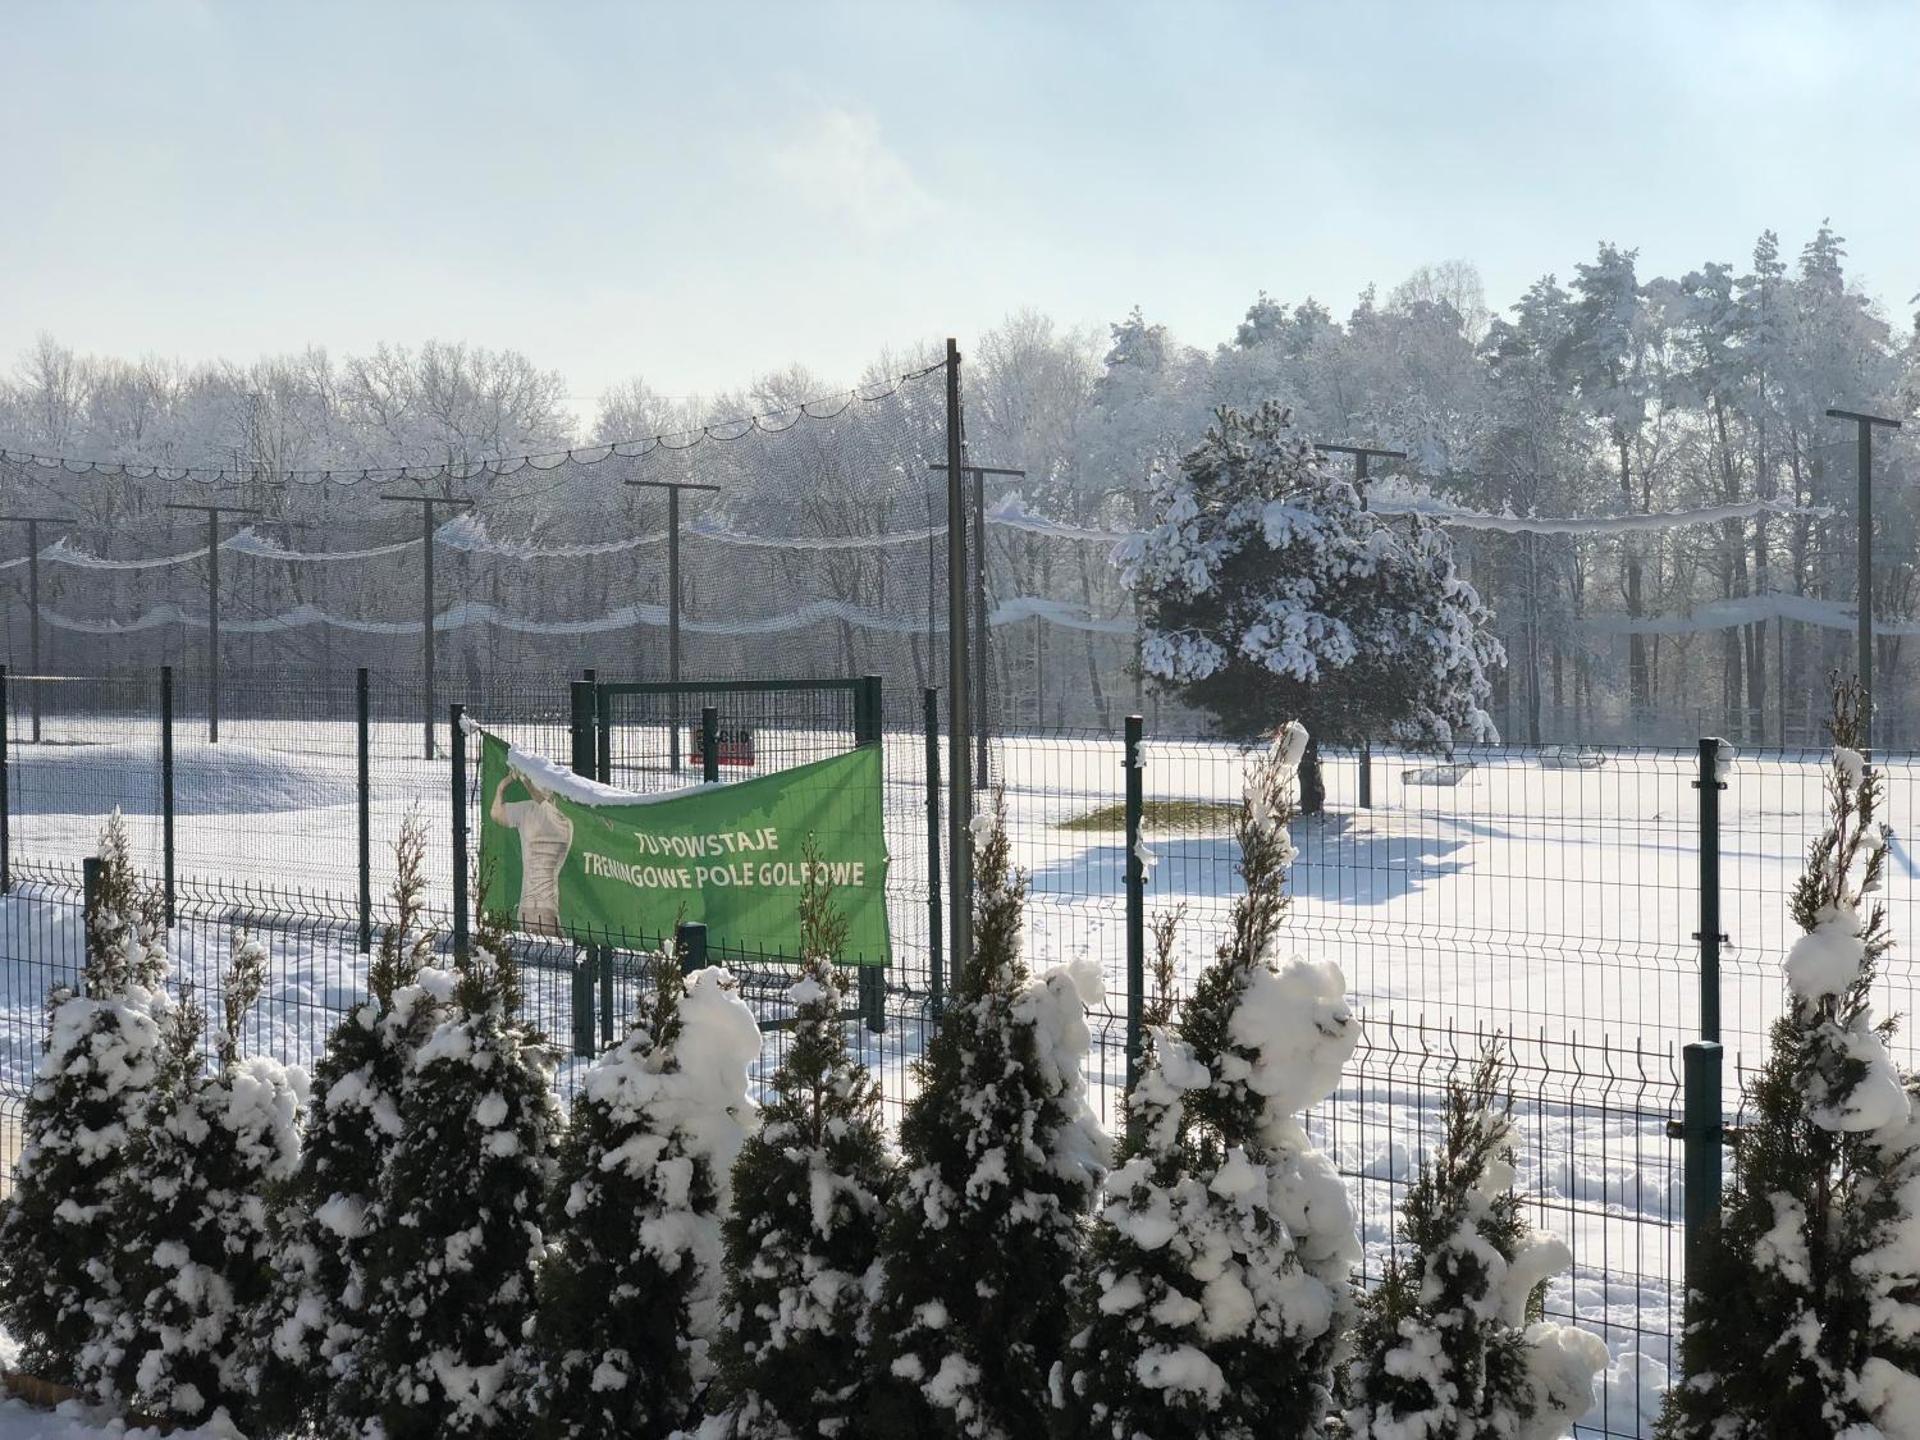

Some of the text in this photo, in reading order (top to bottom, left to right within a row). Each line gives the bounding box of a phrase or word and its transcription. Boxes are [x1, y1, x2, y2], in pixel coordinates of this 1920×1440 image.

[634, 827, 779, 858] TU POWSTAJE
[583, 852, 692, 889] TRENINGOWE
[696, 862, 754, 889] POLE
